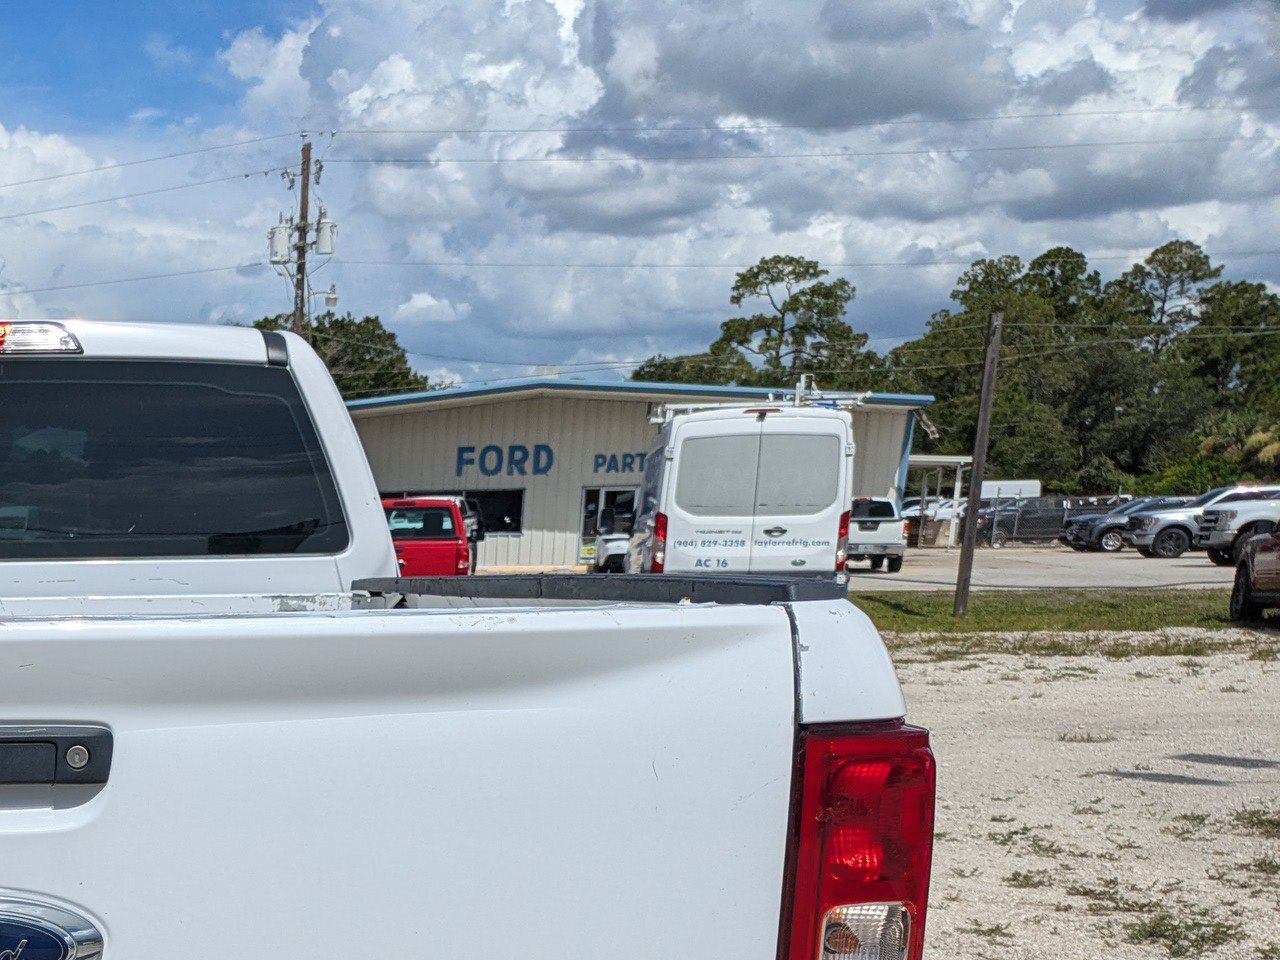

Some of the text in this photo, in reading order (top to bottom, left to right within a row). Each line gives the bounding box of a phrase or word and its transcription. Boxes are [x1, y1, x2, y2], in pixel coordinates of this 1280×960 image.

[455, 444, 555, 477] FORD
[673, 539, 697, 548] (904)
[753, 538, 830, 548] taylorrefrig.com
[694, 558, 728, 568] AC 16
